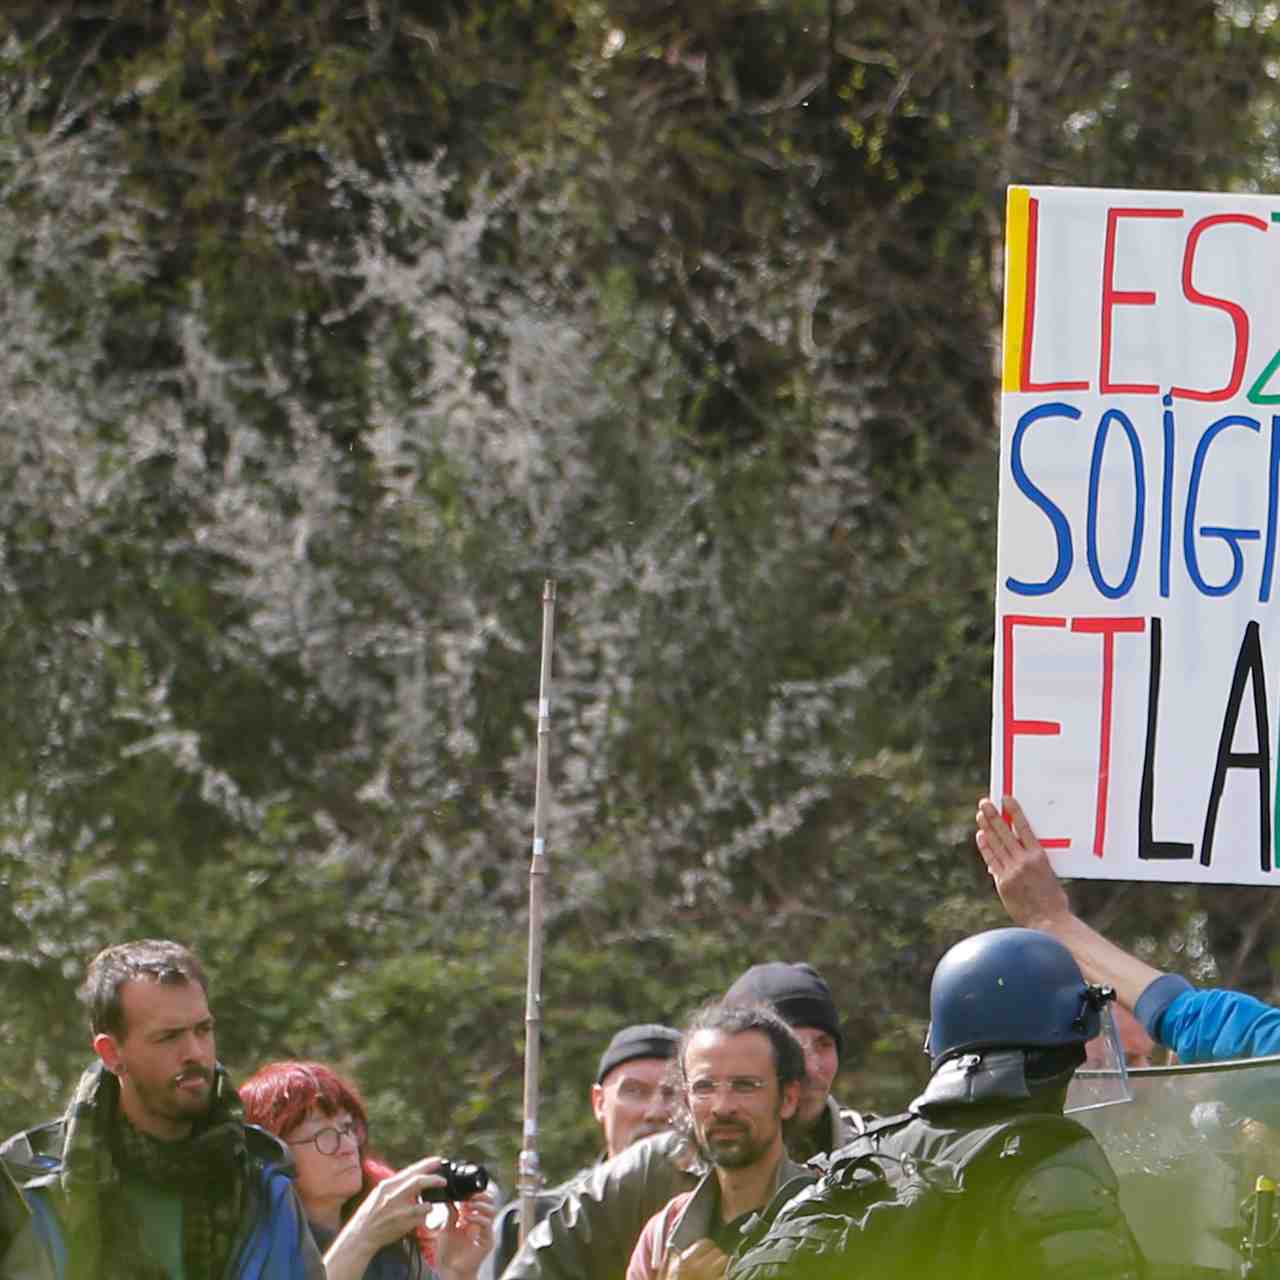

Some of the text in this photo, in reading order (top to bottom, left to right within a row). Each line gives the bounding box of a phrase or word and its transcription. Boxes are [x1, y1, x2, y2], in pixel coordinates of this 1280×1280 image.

[1020, 197, 1269, 401] LES
[1001, 614, 1145, 858] ET
[1137, 616, 1272, 872] LA
